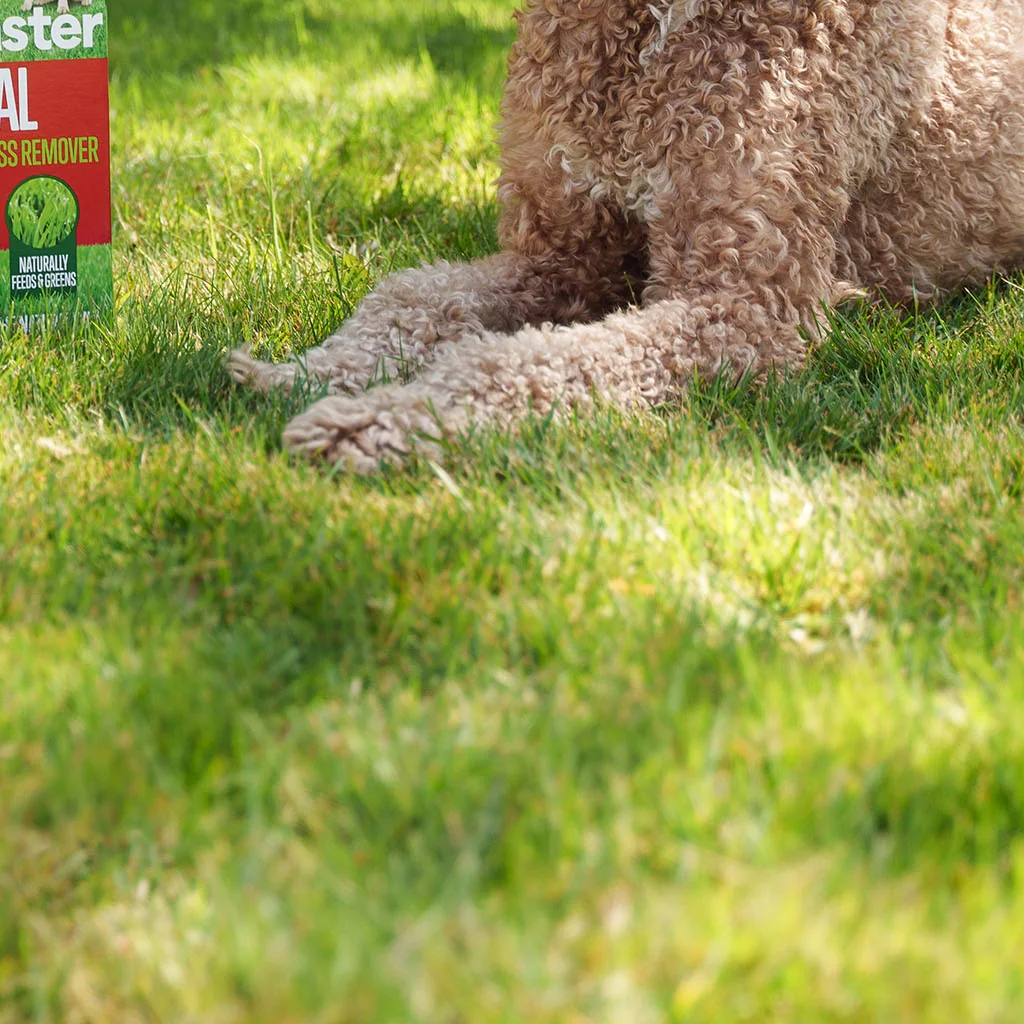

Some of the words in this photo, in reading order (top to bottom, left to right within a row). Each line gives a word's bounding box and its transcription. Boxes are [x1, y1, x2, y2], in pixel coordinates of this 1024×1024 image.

[21, 136, 99, 166] REMOVER
[18, 254, 68, 273] NATURALLY
[11, 274, 36, 290] FEEDS
[37, 273, 44, 288] &
[44, 272, 76, 288] GREENS
